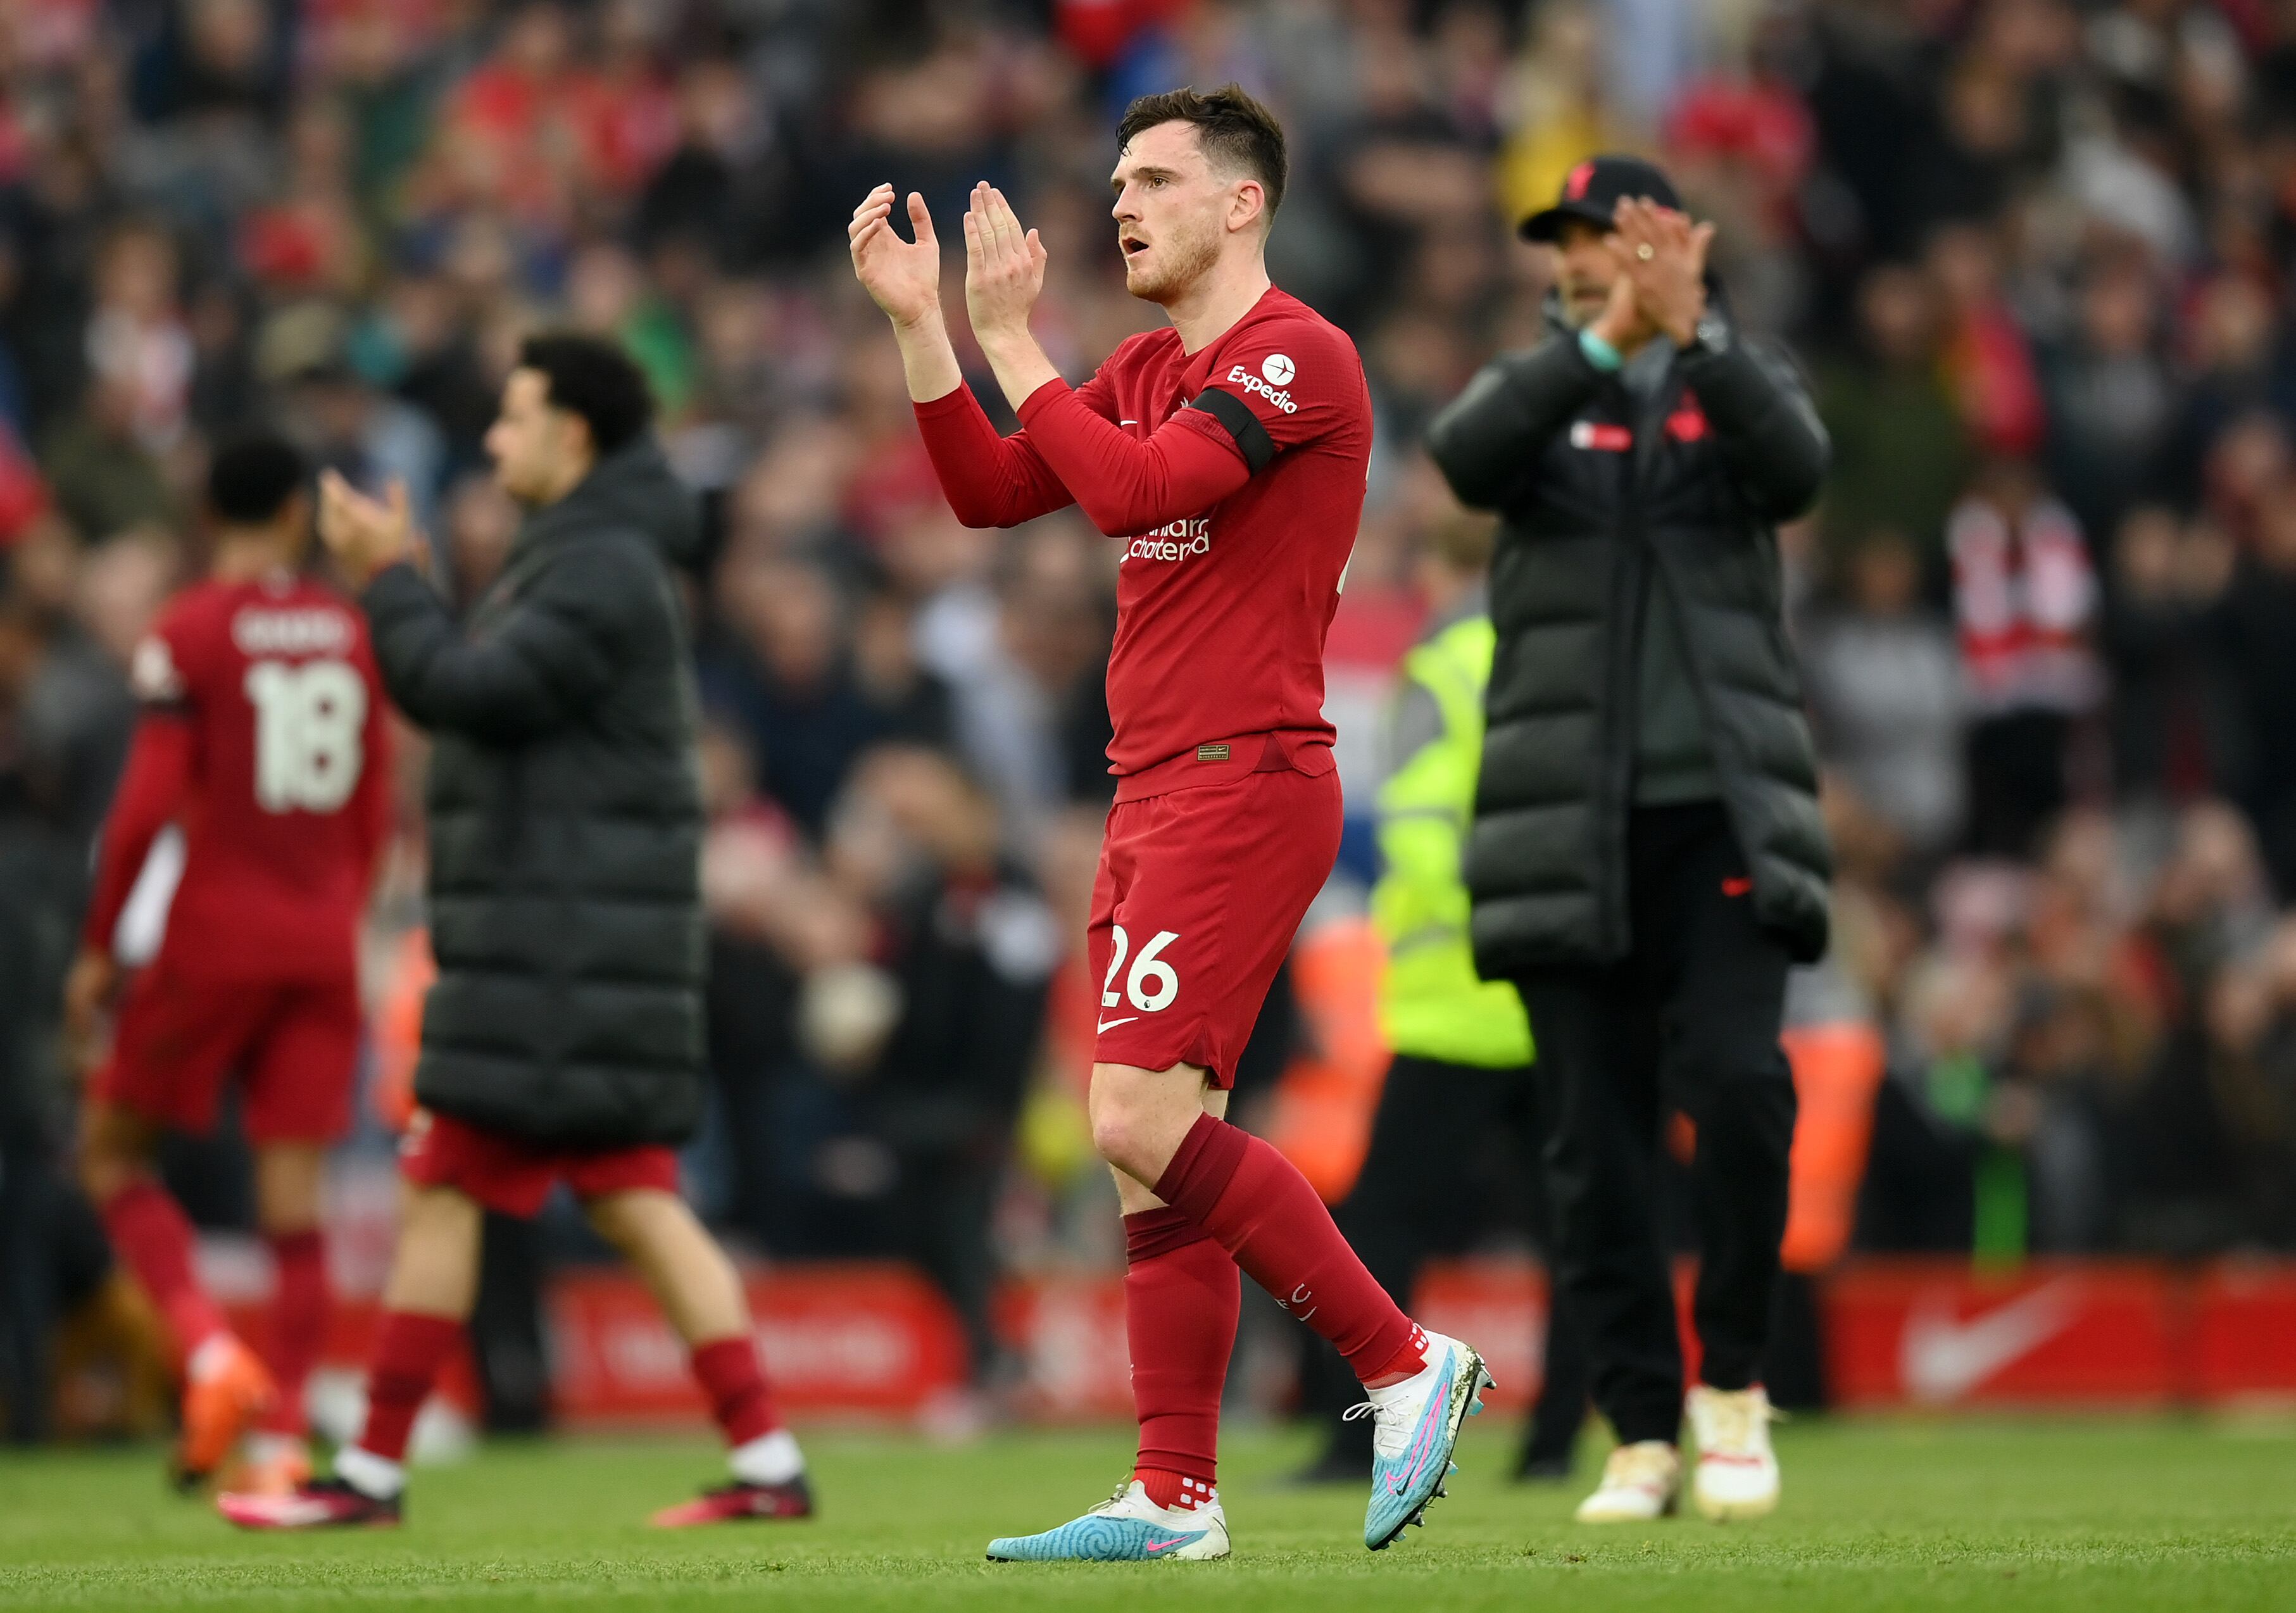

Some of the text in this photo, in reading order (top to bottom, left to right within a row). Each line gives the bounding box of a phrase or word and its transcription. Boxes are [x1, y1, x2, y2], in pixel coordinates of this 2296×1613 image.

[1227, 365, 1298, 414] Expedia
[1130, 530, 1210, 561] charterd
[244, 660, 368, 813] 18
[1101, 925, 1181, 1012] 26
